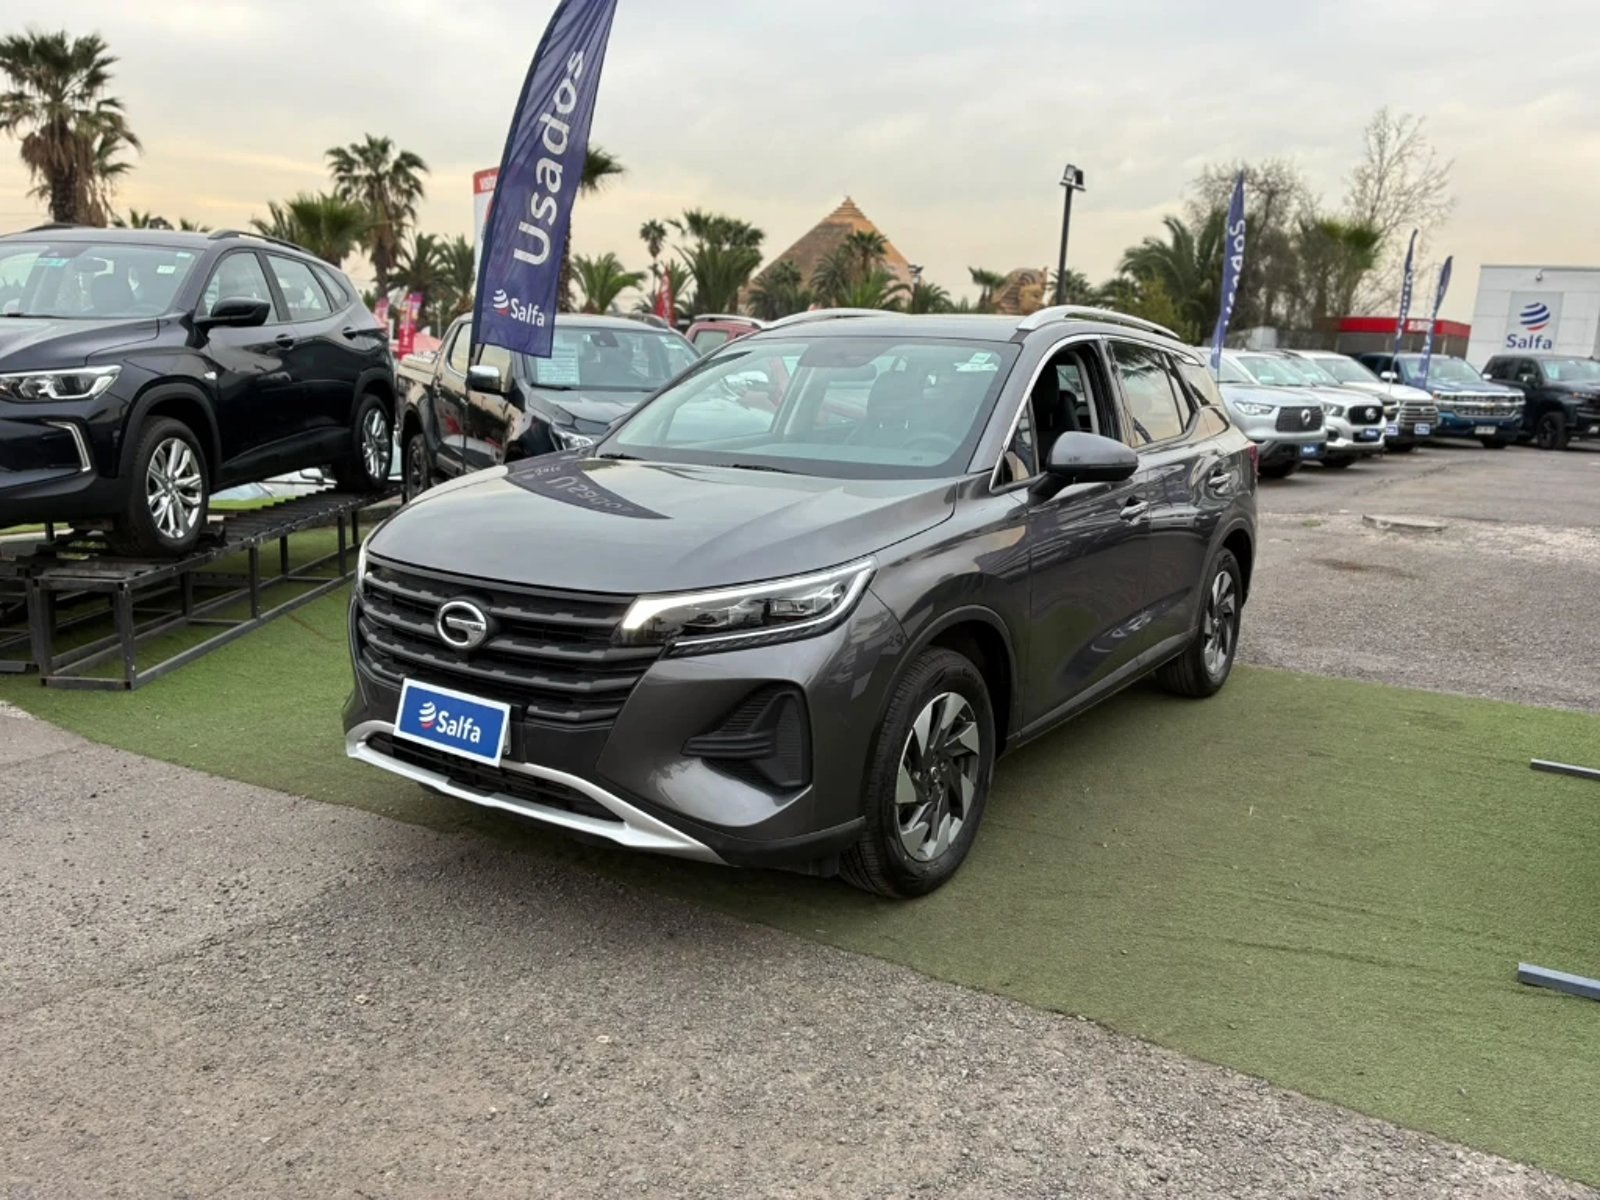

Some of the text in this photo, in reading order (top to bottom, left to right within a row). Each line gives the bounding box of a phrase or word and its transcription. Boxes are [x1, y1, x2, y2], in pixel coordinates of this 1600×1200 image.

[513, 50, 584, 266] Usados
[510, 297, 546, 328] Salfa
[1506, 333, 1553, 351] Salfa
[435, 710, 482, 744] Salfa
